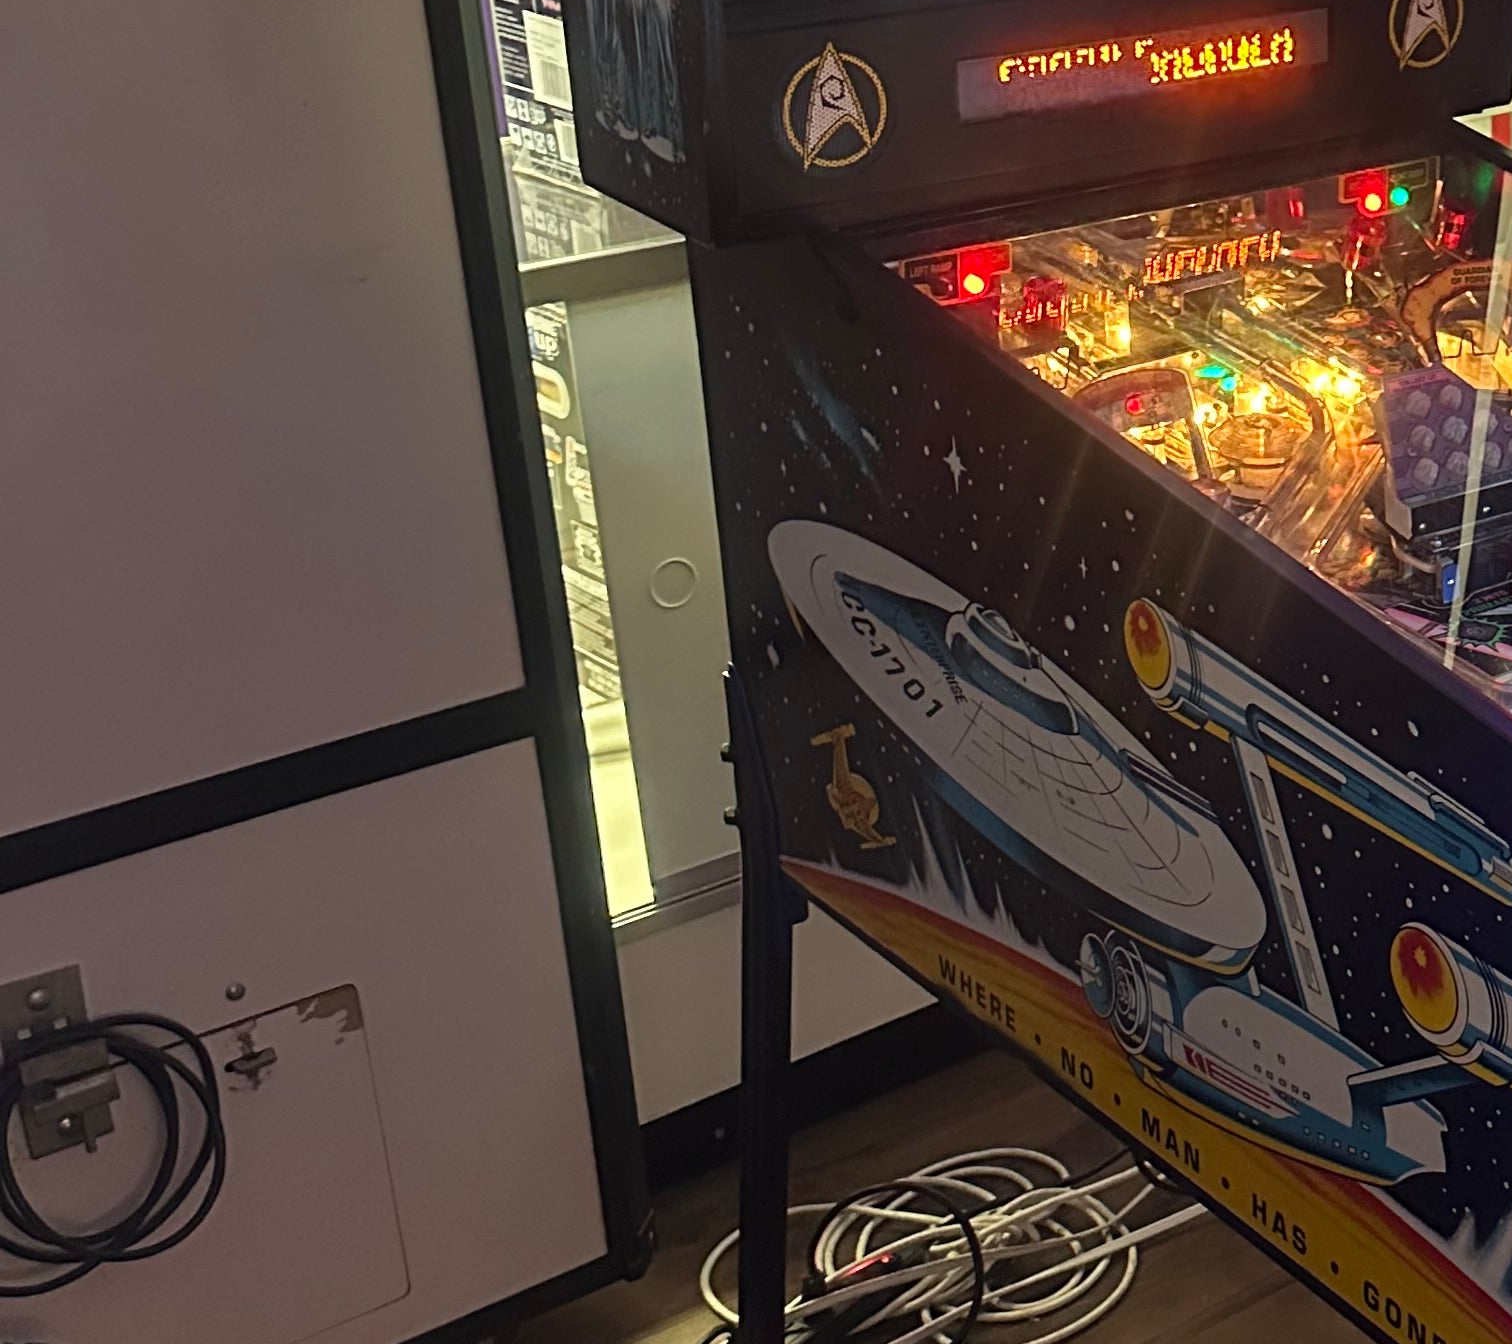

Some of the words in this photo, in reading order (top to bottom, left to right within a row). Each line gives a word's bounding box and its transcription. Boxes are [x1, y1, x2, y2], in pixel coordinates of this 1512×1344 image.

[839, 582, 944, 718] CC-1701
[938, 953, 1017, 1033] WHERE
[1060, 1045, 1094, 1090] NO
[1142, 1107, 1201, 1174] MAN
[1251, 1192, 1307, 1256] HAS
